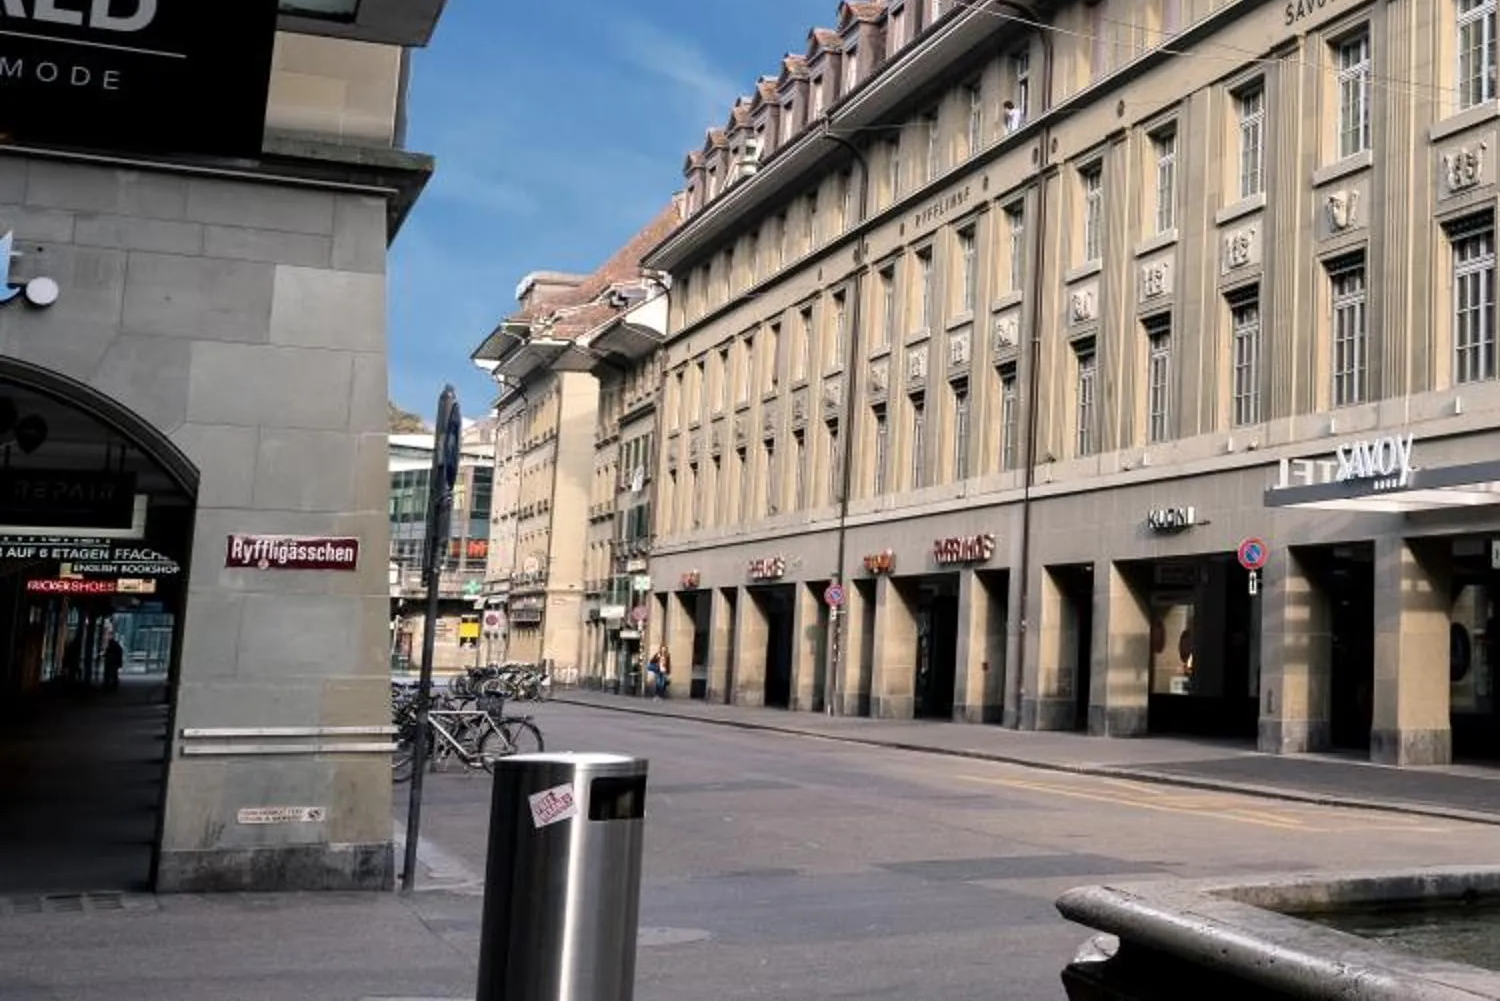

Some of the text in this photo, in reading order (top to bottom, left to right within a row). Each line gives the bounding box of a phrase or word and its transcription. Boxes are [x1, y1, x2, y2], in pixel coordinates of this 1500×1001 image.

[0, 56, 120, 90] MODE
[1336, 433, 1413, 486] SAVOY
[5, 546, 36, 558] AUF
[51, 548, 110, 560] ETAGEN
[231, 535, 354, 565] Ryffligässchen
